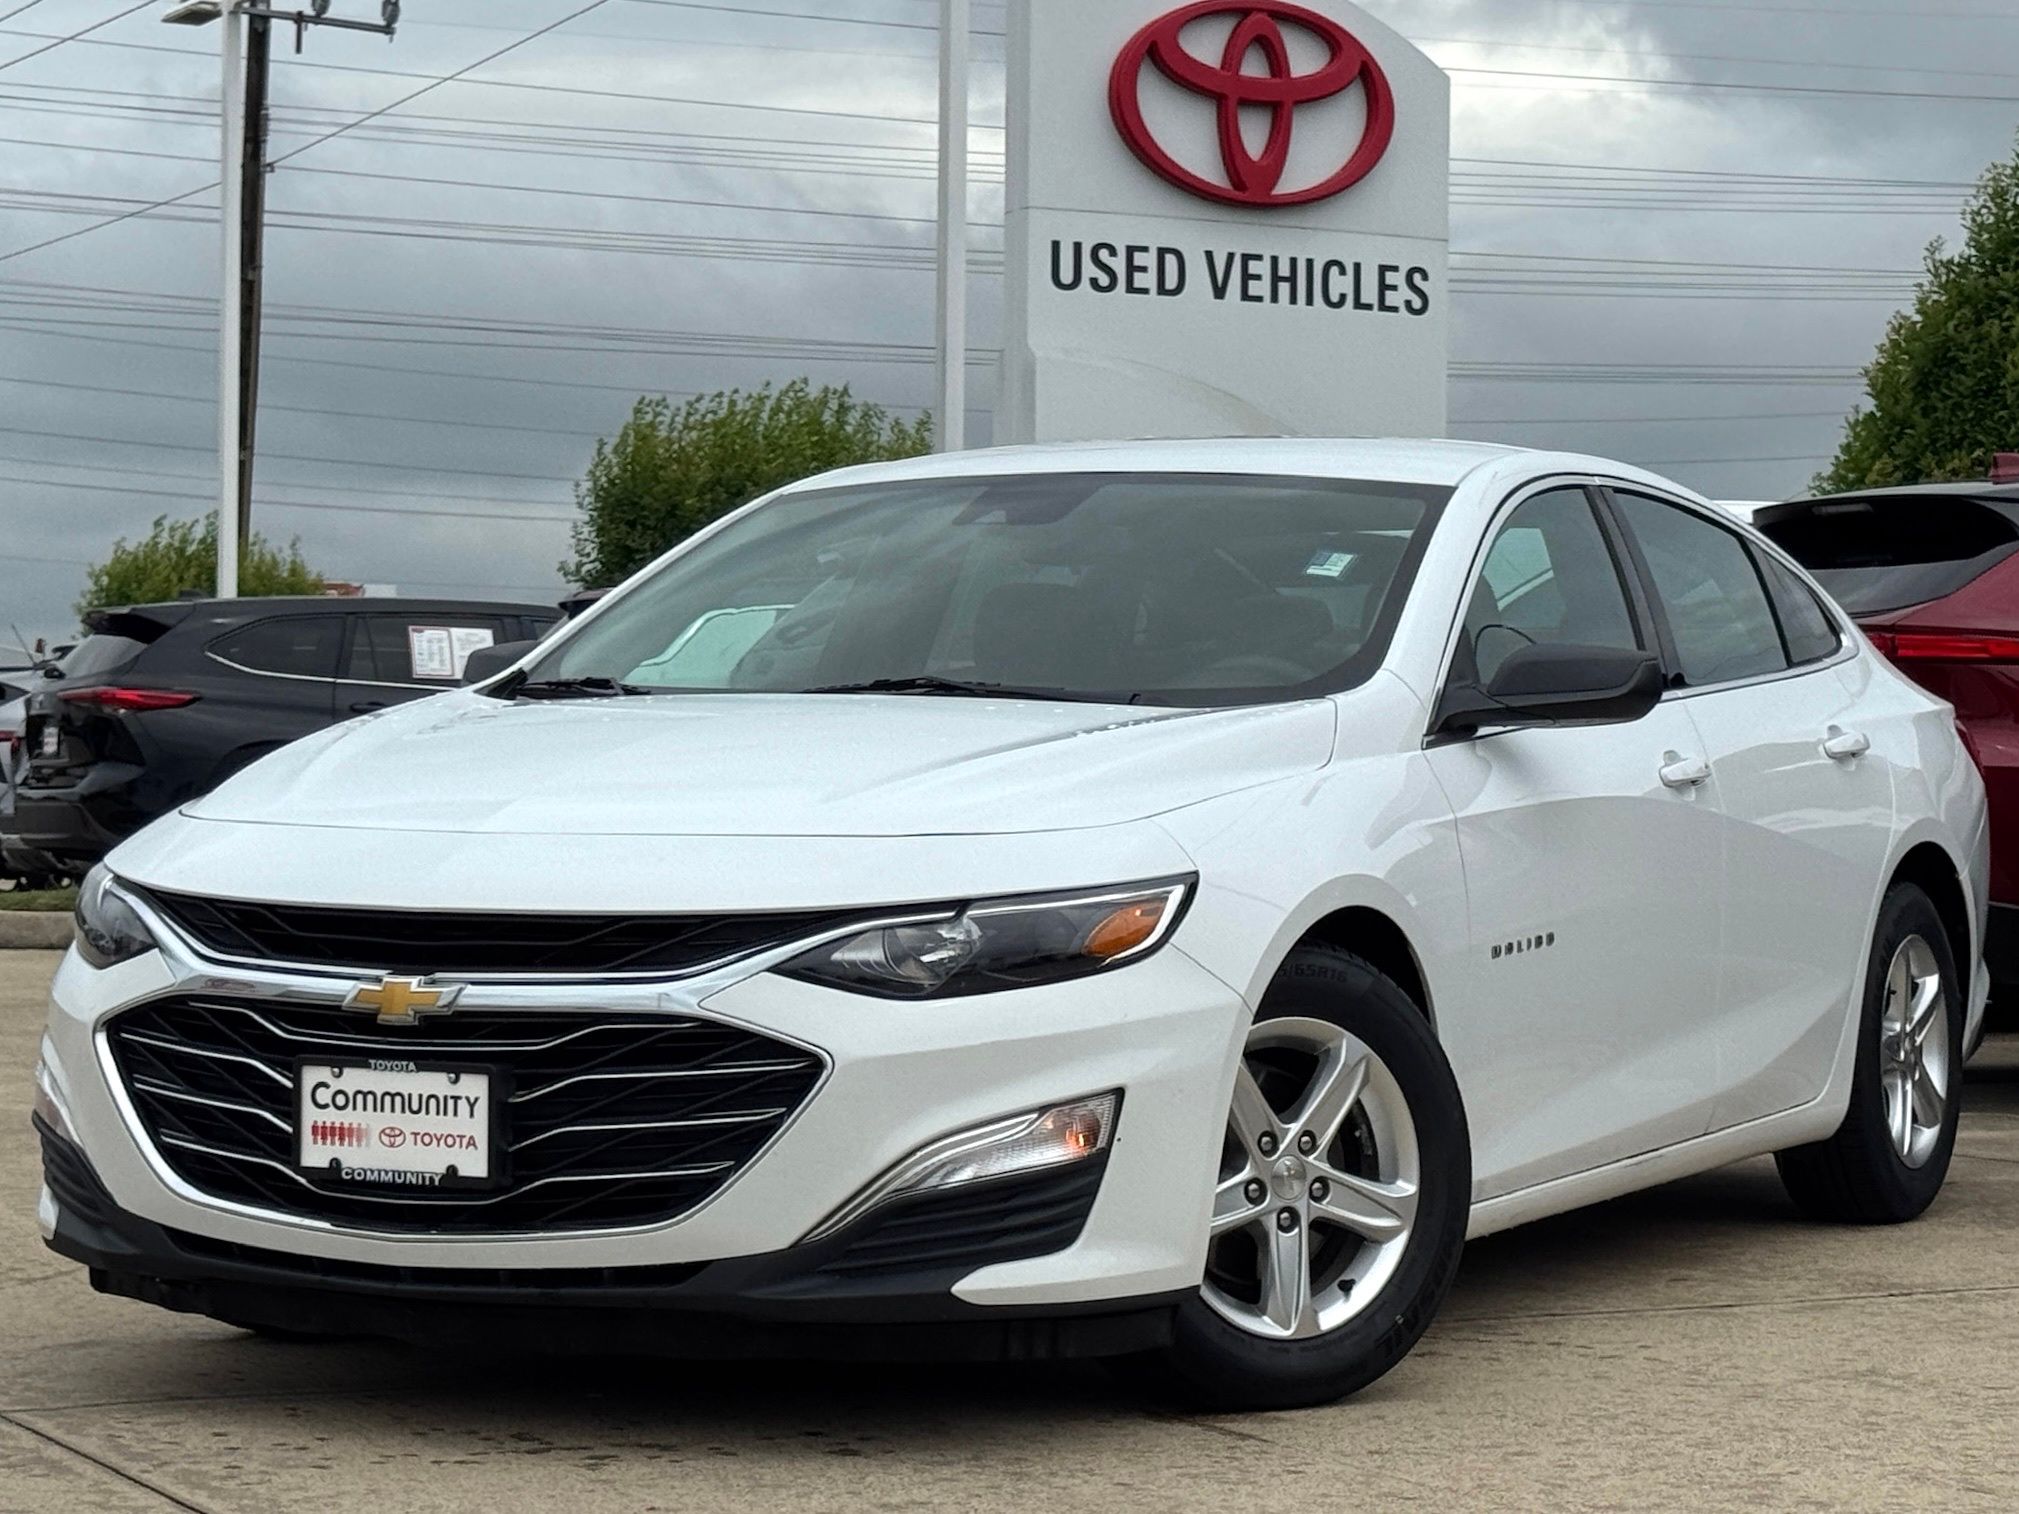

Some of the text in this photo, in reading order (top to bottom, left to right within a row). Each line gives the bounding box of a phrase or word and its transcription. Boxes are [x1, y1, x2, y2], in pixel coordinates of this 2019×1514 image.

[1050, 239, 1430, 316] USED VEHICLES
[368, 1059, 417, 1073] TOYOTA
[410, 1131, 479, 1151] TOYOTA
[341, 1167, 444, 1187] COMMUNITY
